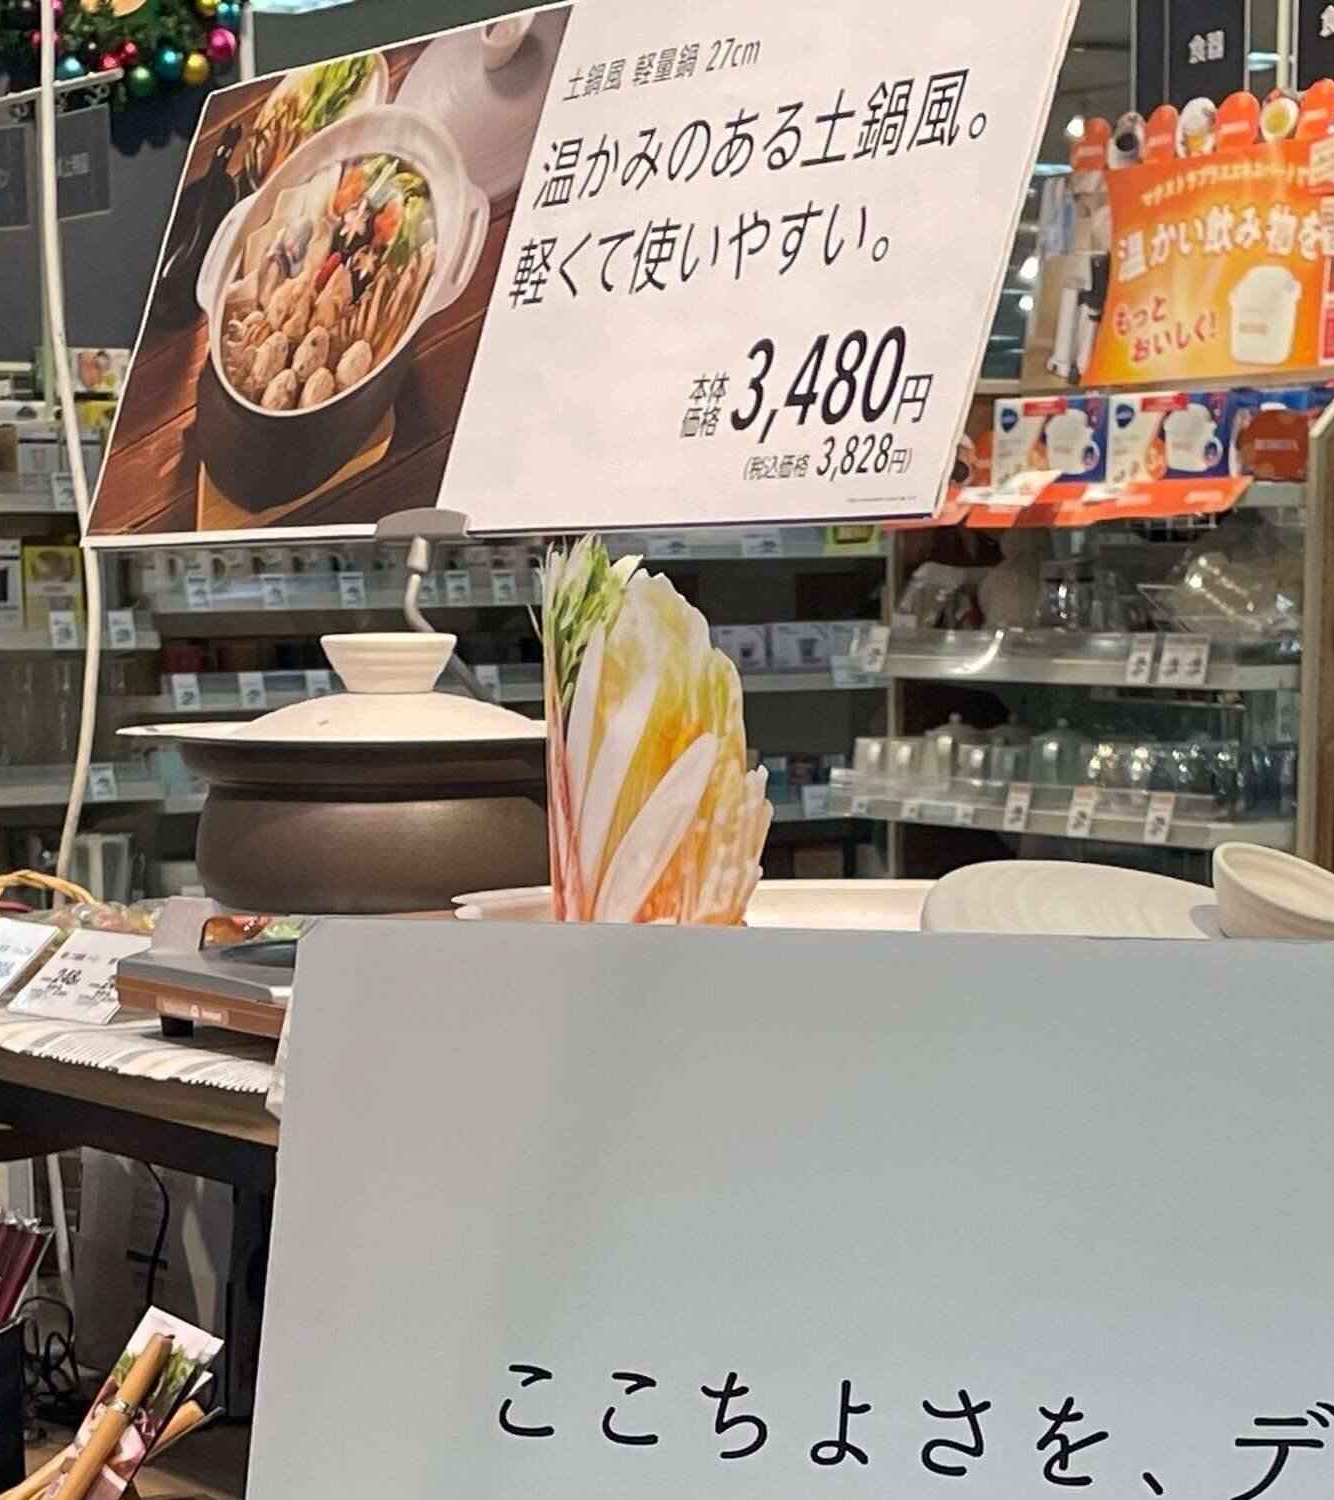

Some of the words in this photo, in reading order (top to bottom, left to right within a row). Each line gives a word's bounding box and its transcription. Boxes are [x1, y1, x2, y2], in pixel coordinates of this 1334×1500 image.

[563, 58, 625, 102] 土鍋風
[632, 43, 699, 86] 軽量鍋
[705, 38, 762, 72] 27cm
[533, 69, 987, 210] 温かみのある土鍋風。
[509, 201, 890, 308] 軽くて使いやすい。
[681, 408, 719, 438] 価格
[731, 326, 933, 444] 3,480円
[689, 374, 729, 404] 本体
